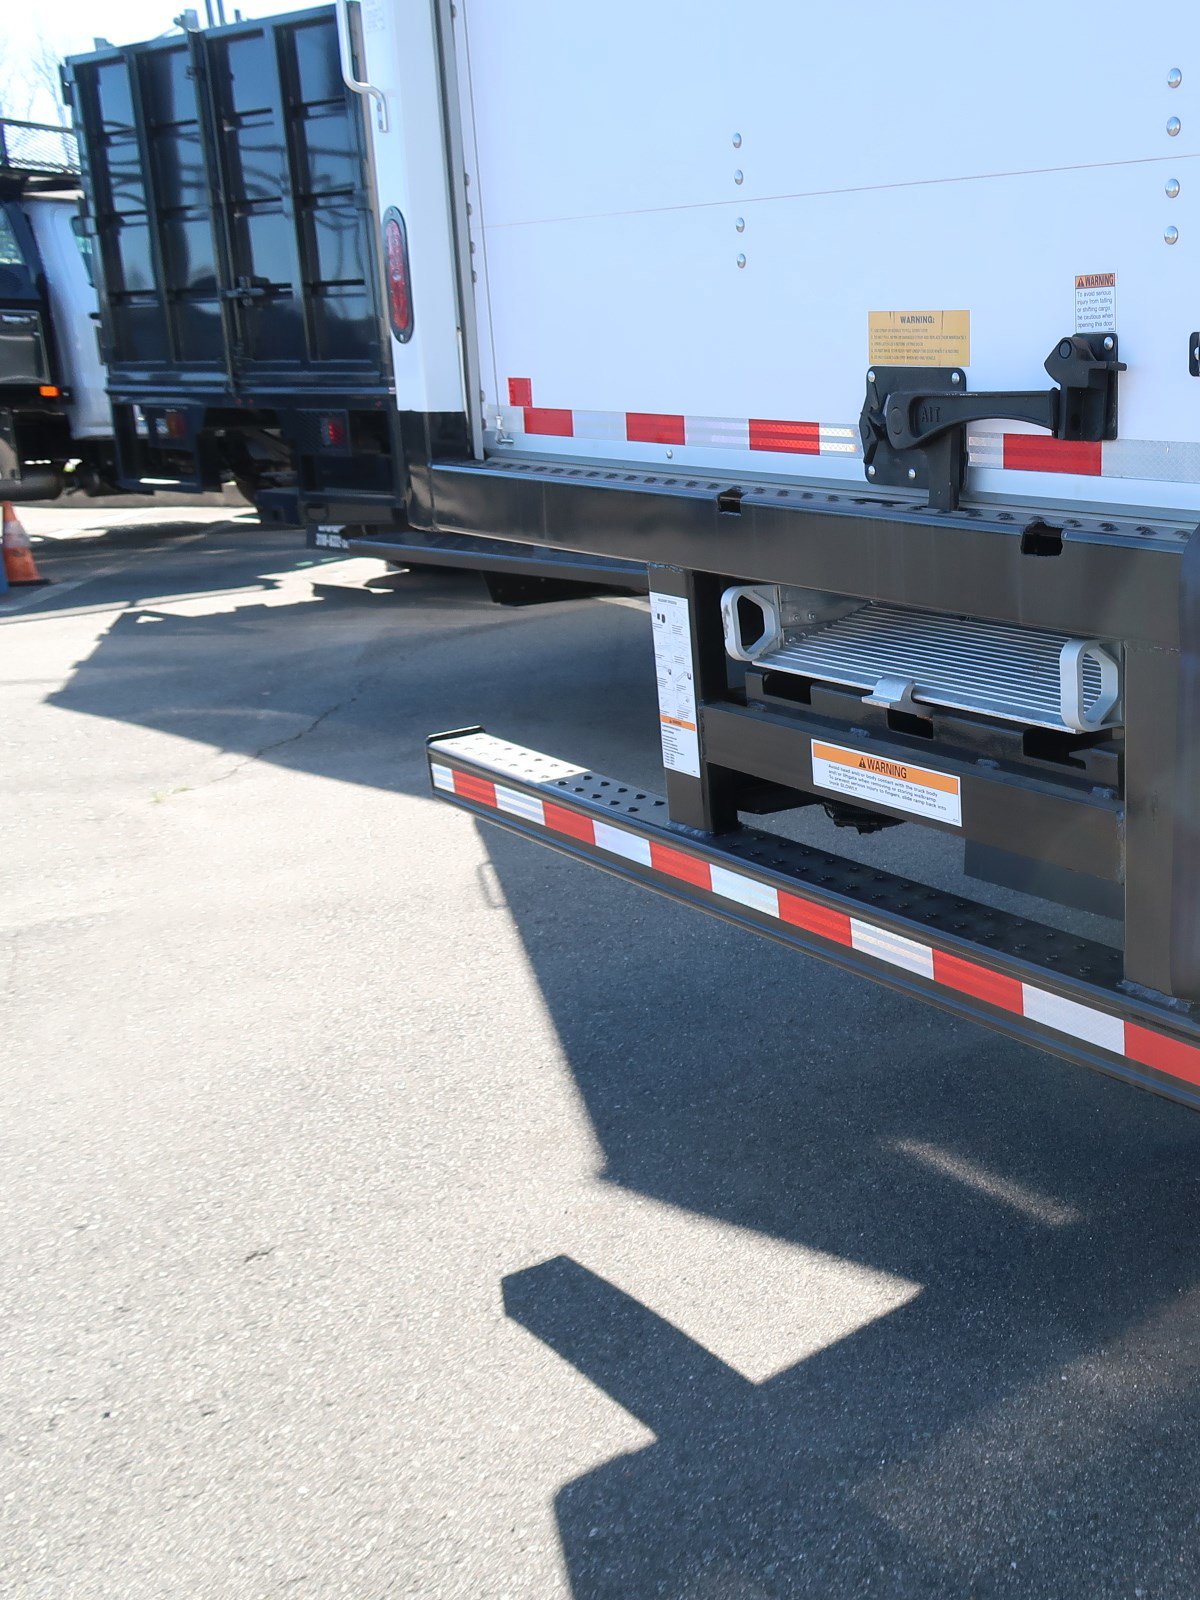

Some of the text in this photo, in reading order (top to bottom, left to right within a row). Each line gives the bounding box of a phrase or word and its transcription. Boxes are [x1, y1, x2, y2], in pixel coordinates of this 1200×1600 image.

[1085, 274, 1114, 287] WARNING
[900, 315, 935, 324] WARNING:
[867, 759, 907, 779] WARNING
[834, 776, 850, 784] prevent
[866, 784, 879, 792] injury
[878, 777, 894, 785] contact
[871, 781, 891, 790] removing
[897, 788, 913, 797] storing
